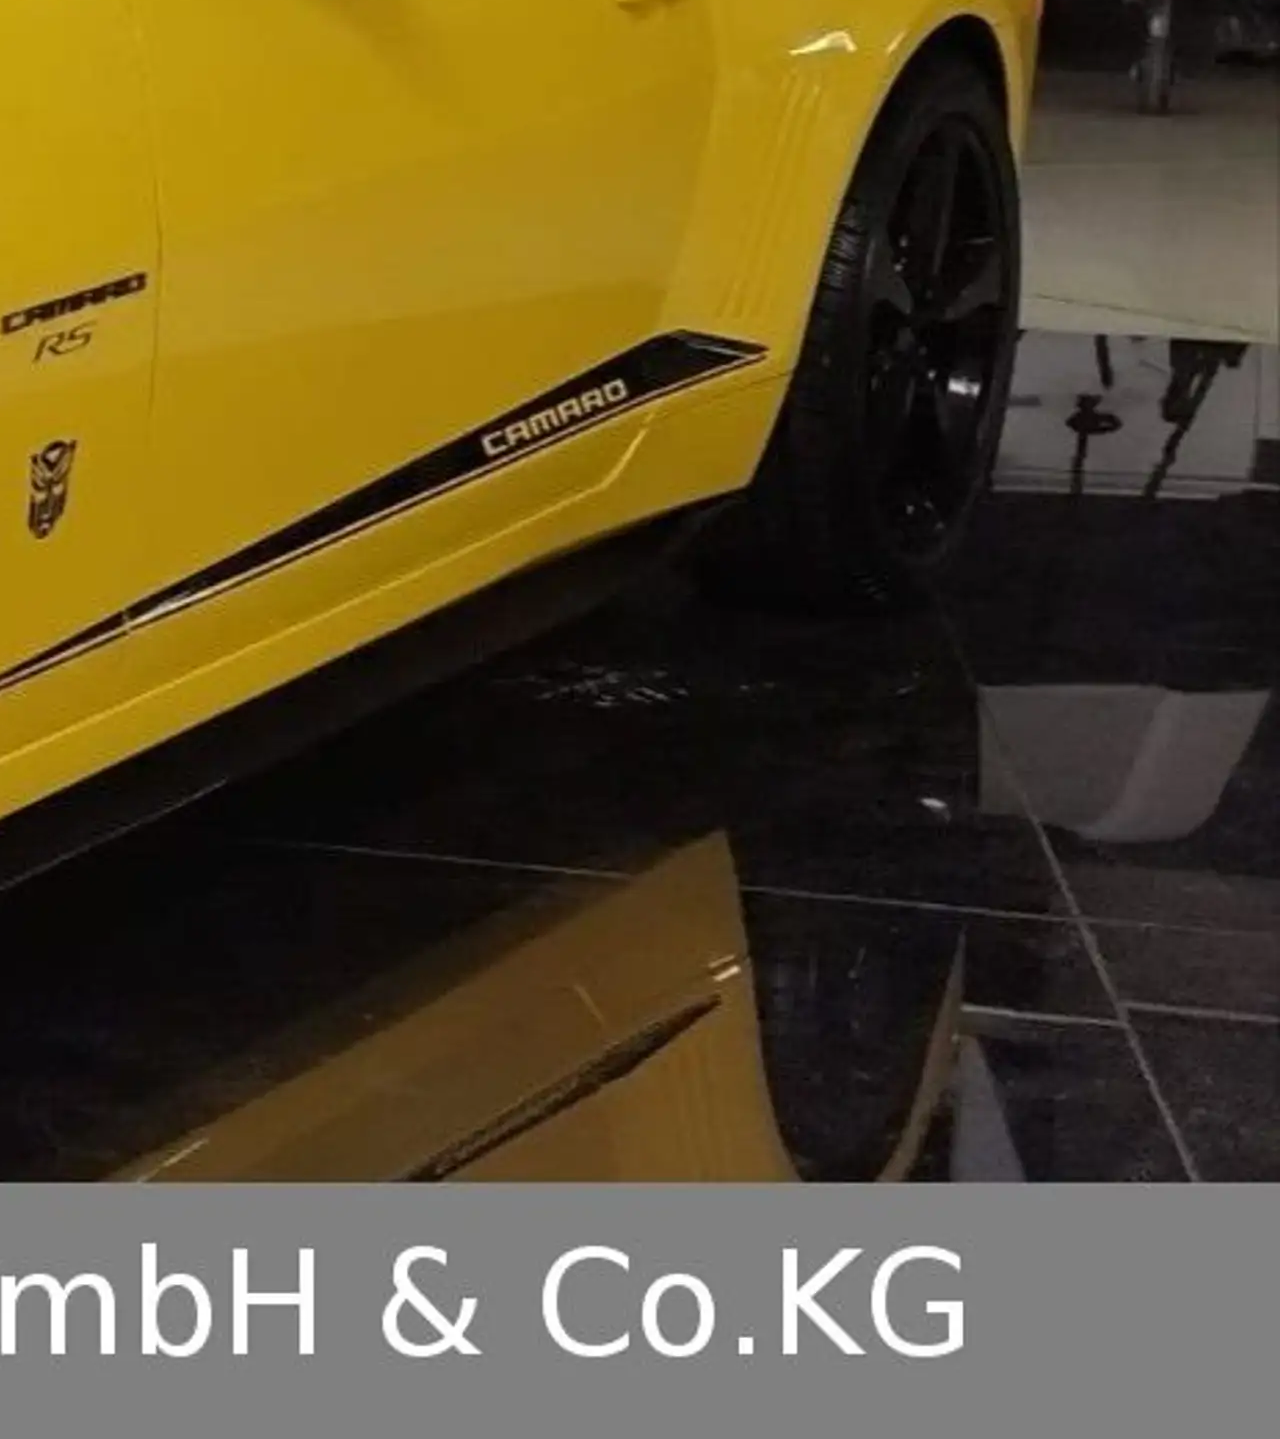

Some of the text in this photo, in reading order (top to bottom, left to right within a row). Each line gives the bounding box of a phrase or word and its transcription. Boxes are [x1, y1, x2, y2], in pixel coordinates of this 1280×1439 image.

[1, 272, 148, 335] CAMARO
[32, 319, 97, 363] RS
[479, 377, 630, 457] CAMARO
